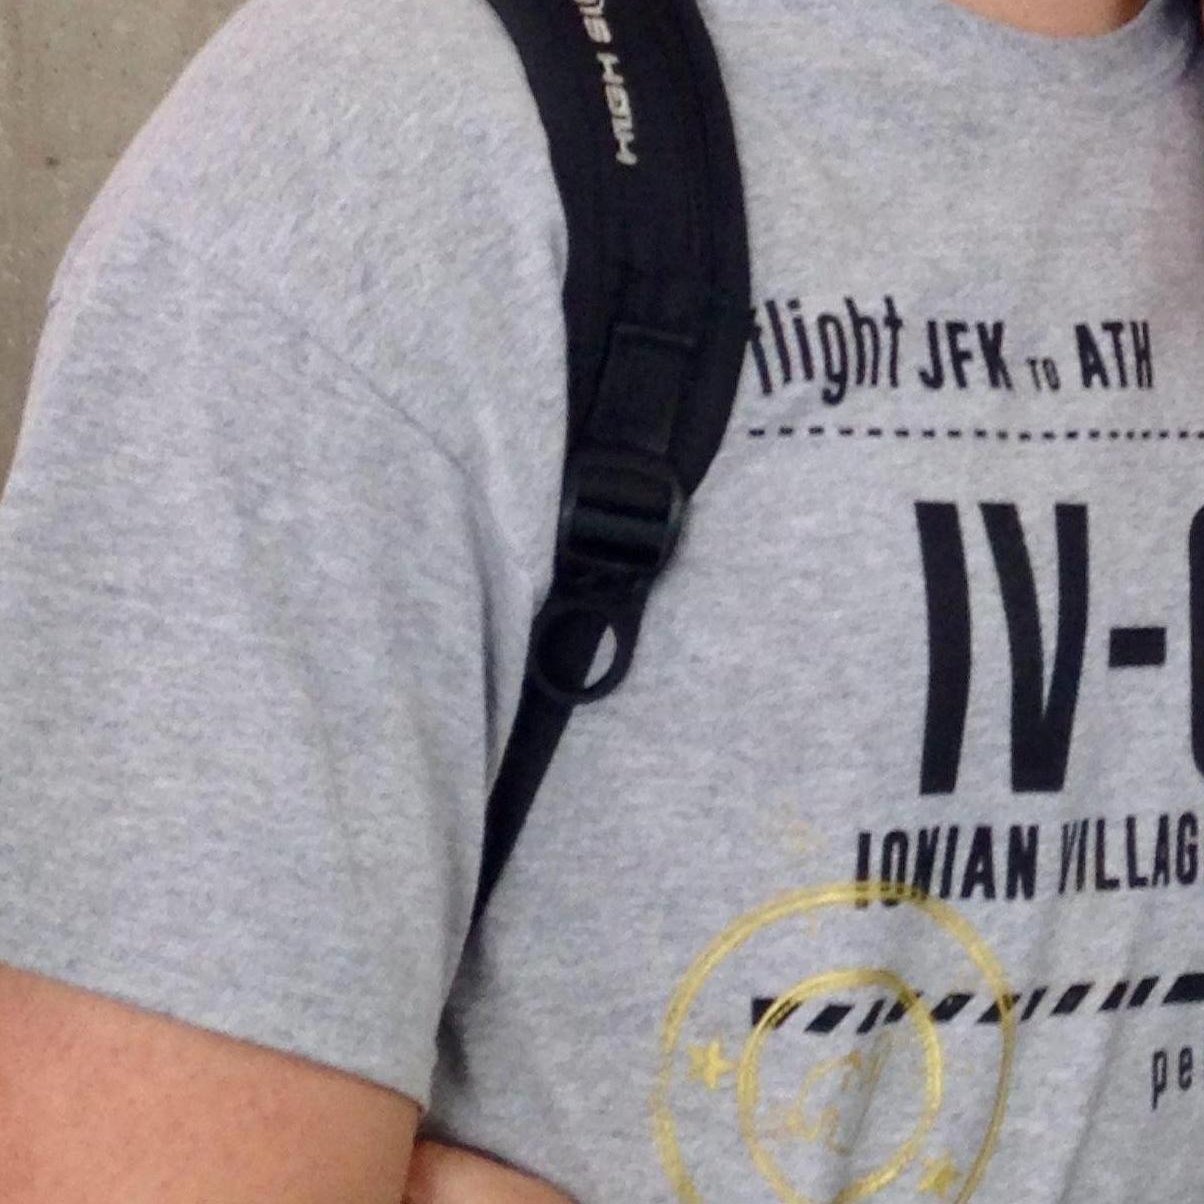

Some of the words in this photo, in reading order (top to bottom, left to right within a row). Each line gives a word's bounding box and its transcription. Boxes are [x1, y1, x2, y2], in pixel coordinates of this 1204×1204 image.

[596, 51, 638, 166] HIGH
[918, 318, 1013, 393] JFK
[1025, 356, 1061, 392] TO
[1074, 319, 1155, 391] ATH
[855, 822, 1040, 908] IONIAN
